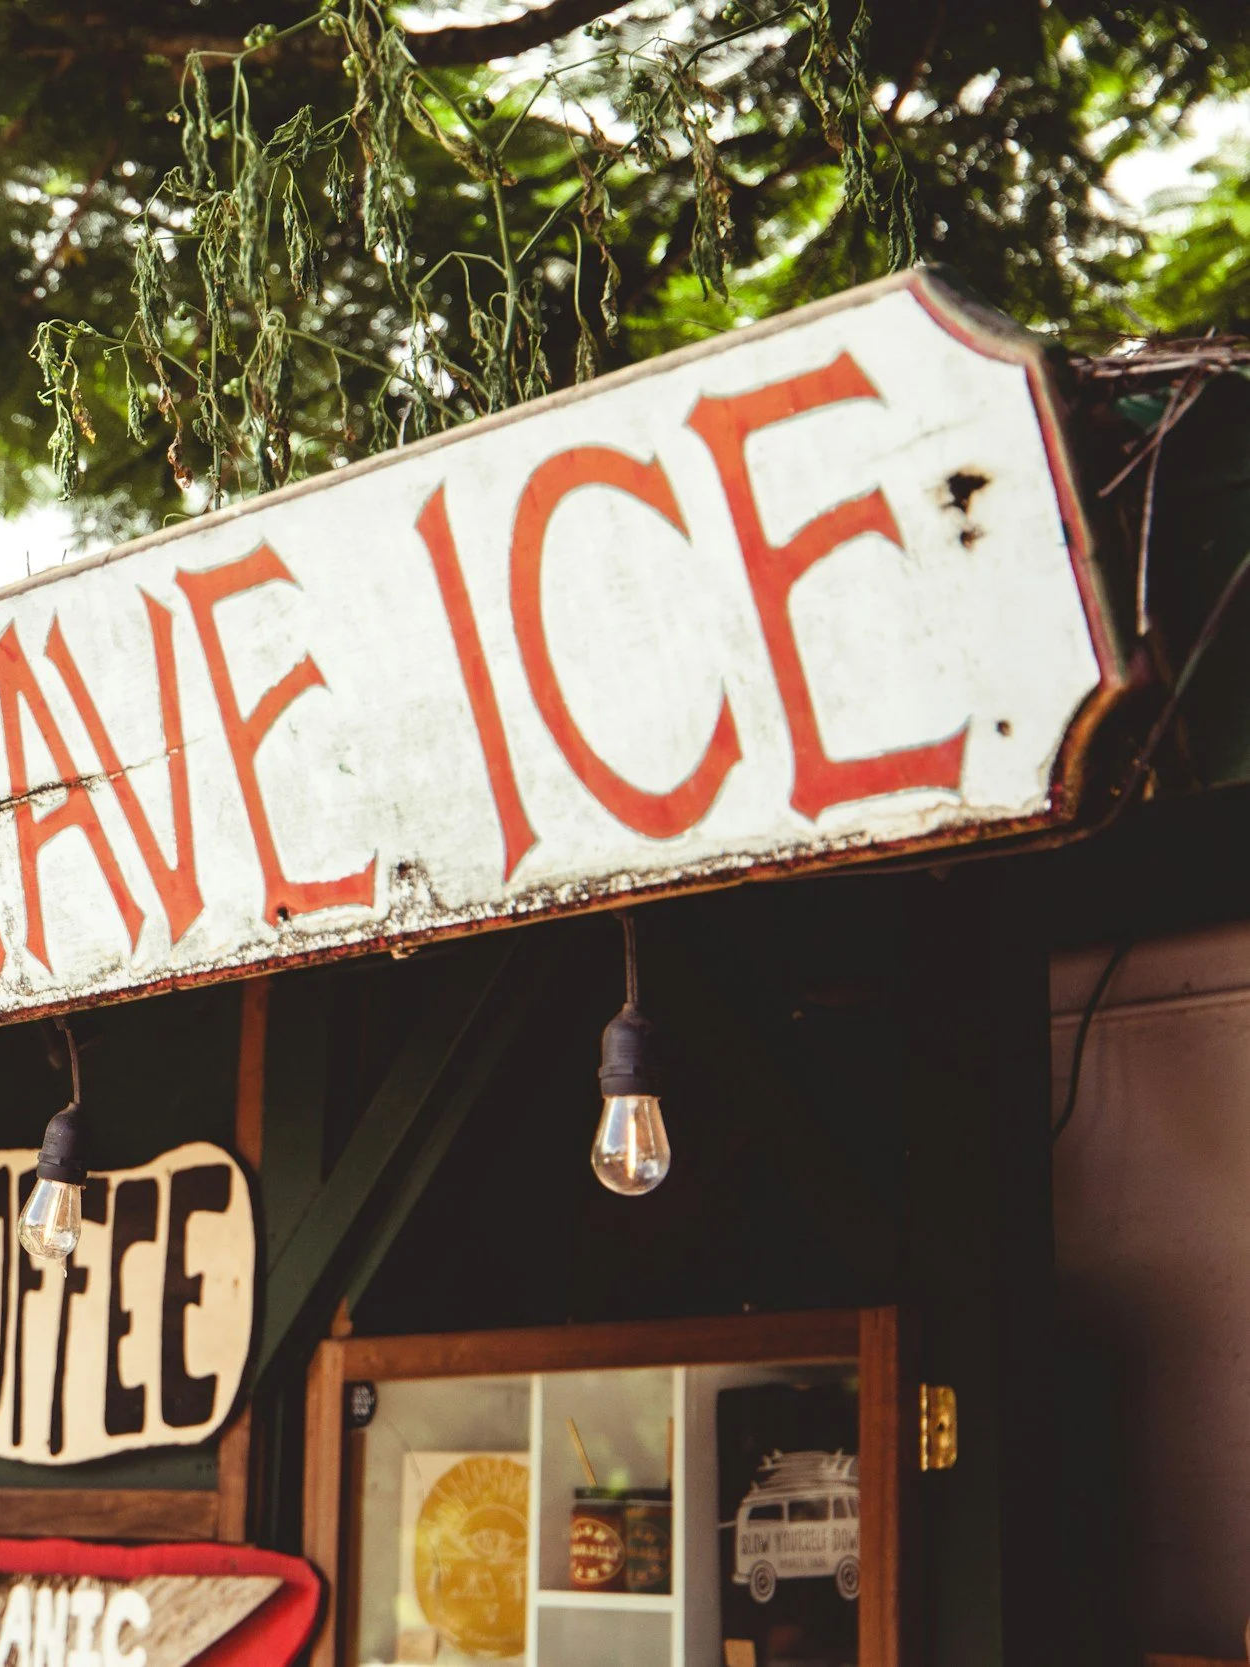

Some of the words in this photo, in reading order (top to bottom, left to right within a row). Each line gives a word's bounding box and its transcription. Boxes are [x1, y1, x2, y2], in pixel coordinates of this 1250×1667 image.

[414, 351, 972, 883] ICE
[741, 1533, 770, 1555] SLOW
[774, 1528, 828, 1553] YOURSELF
